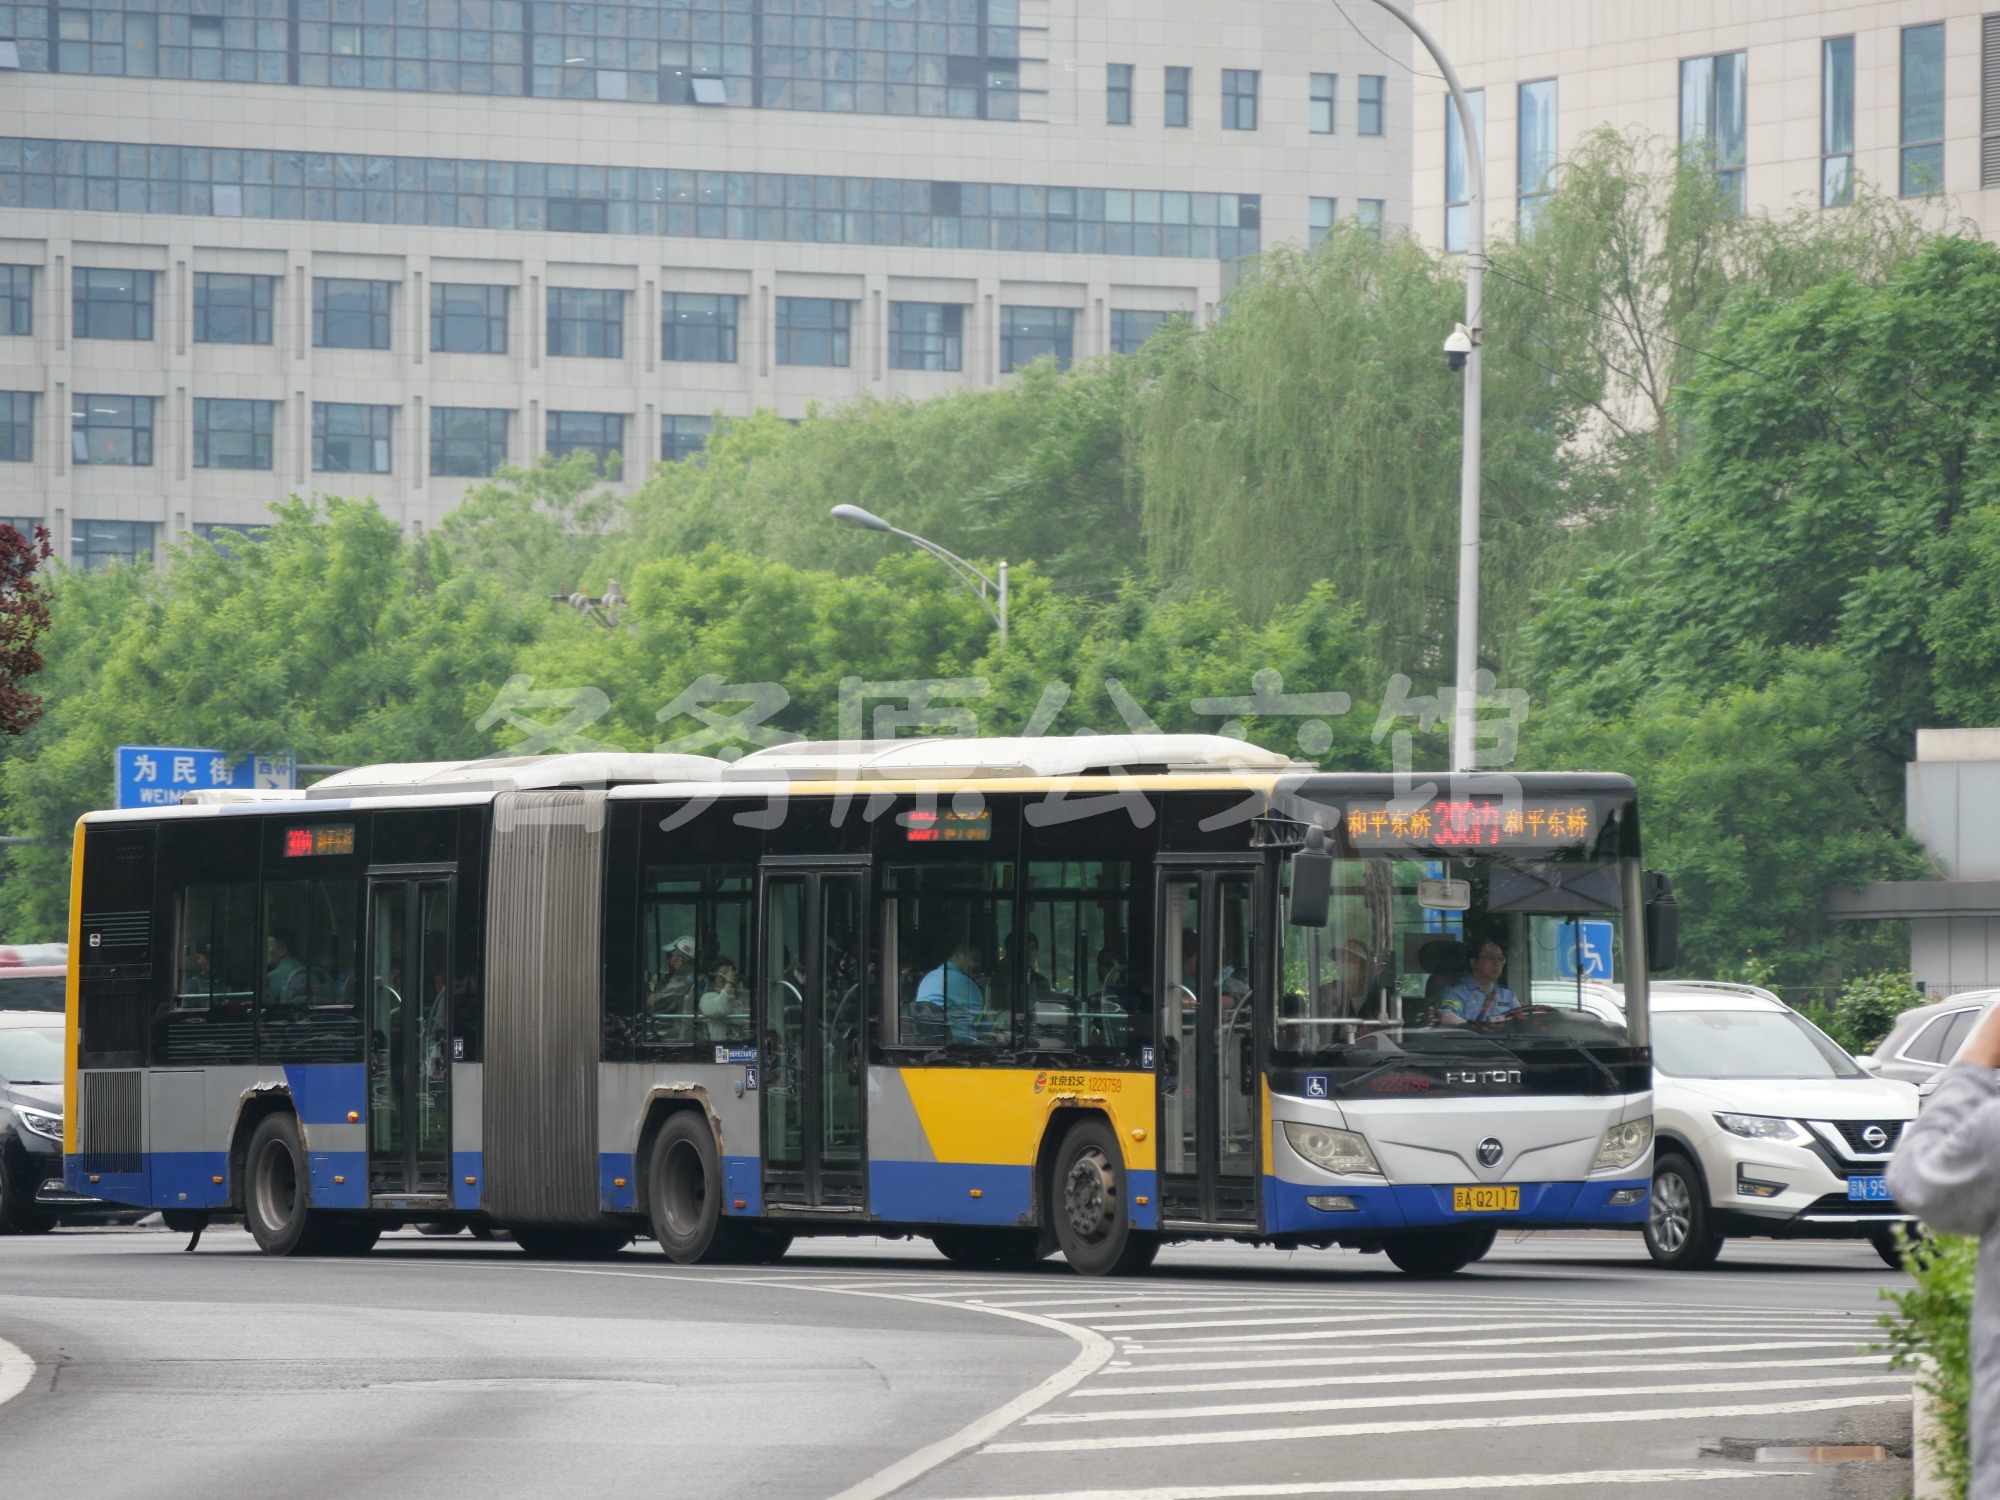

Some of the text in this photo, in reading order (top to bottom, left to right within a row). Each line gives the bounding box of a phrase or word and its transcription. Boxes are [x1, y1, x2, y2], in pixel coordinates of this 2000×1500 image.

[133, 754, 234, 785] 为民街
[1348, 808, 1432, 838] 和平东桥
[1504, 808, 1588, 838] 和平东桥
[1049, 1075, 1085, 1087] 北京公交
[1088, 1076, 1122, 1093] 1223759
[1372, 1076, 1430, 1093] 1223759
[1446, 1070, 1522, 1085] FOTON
